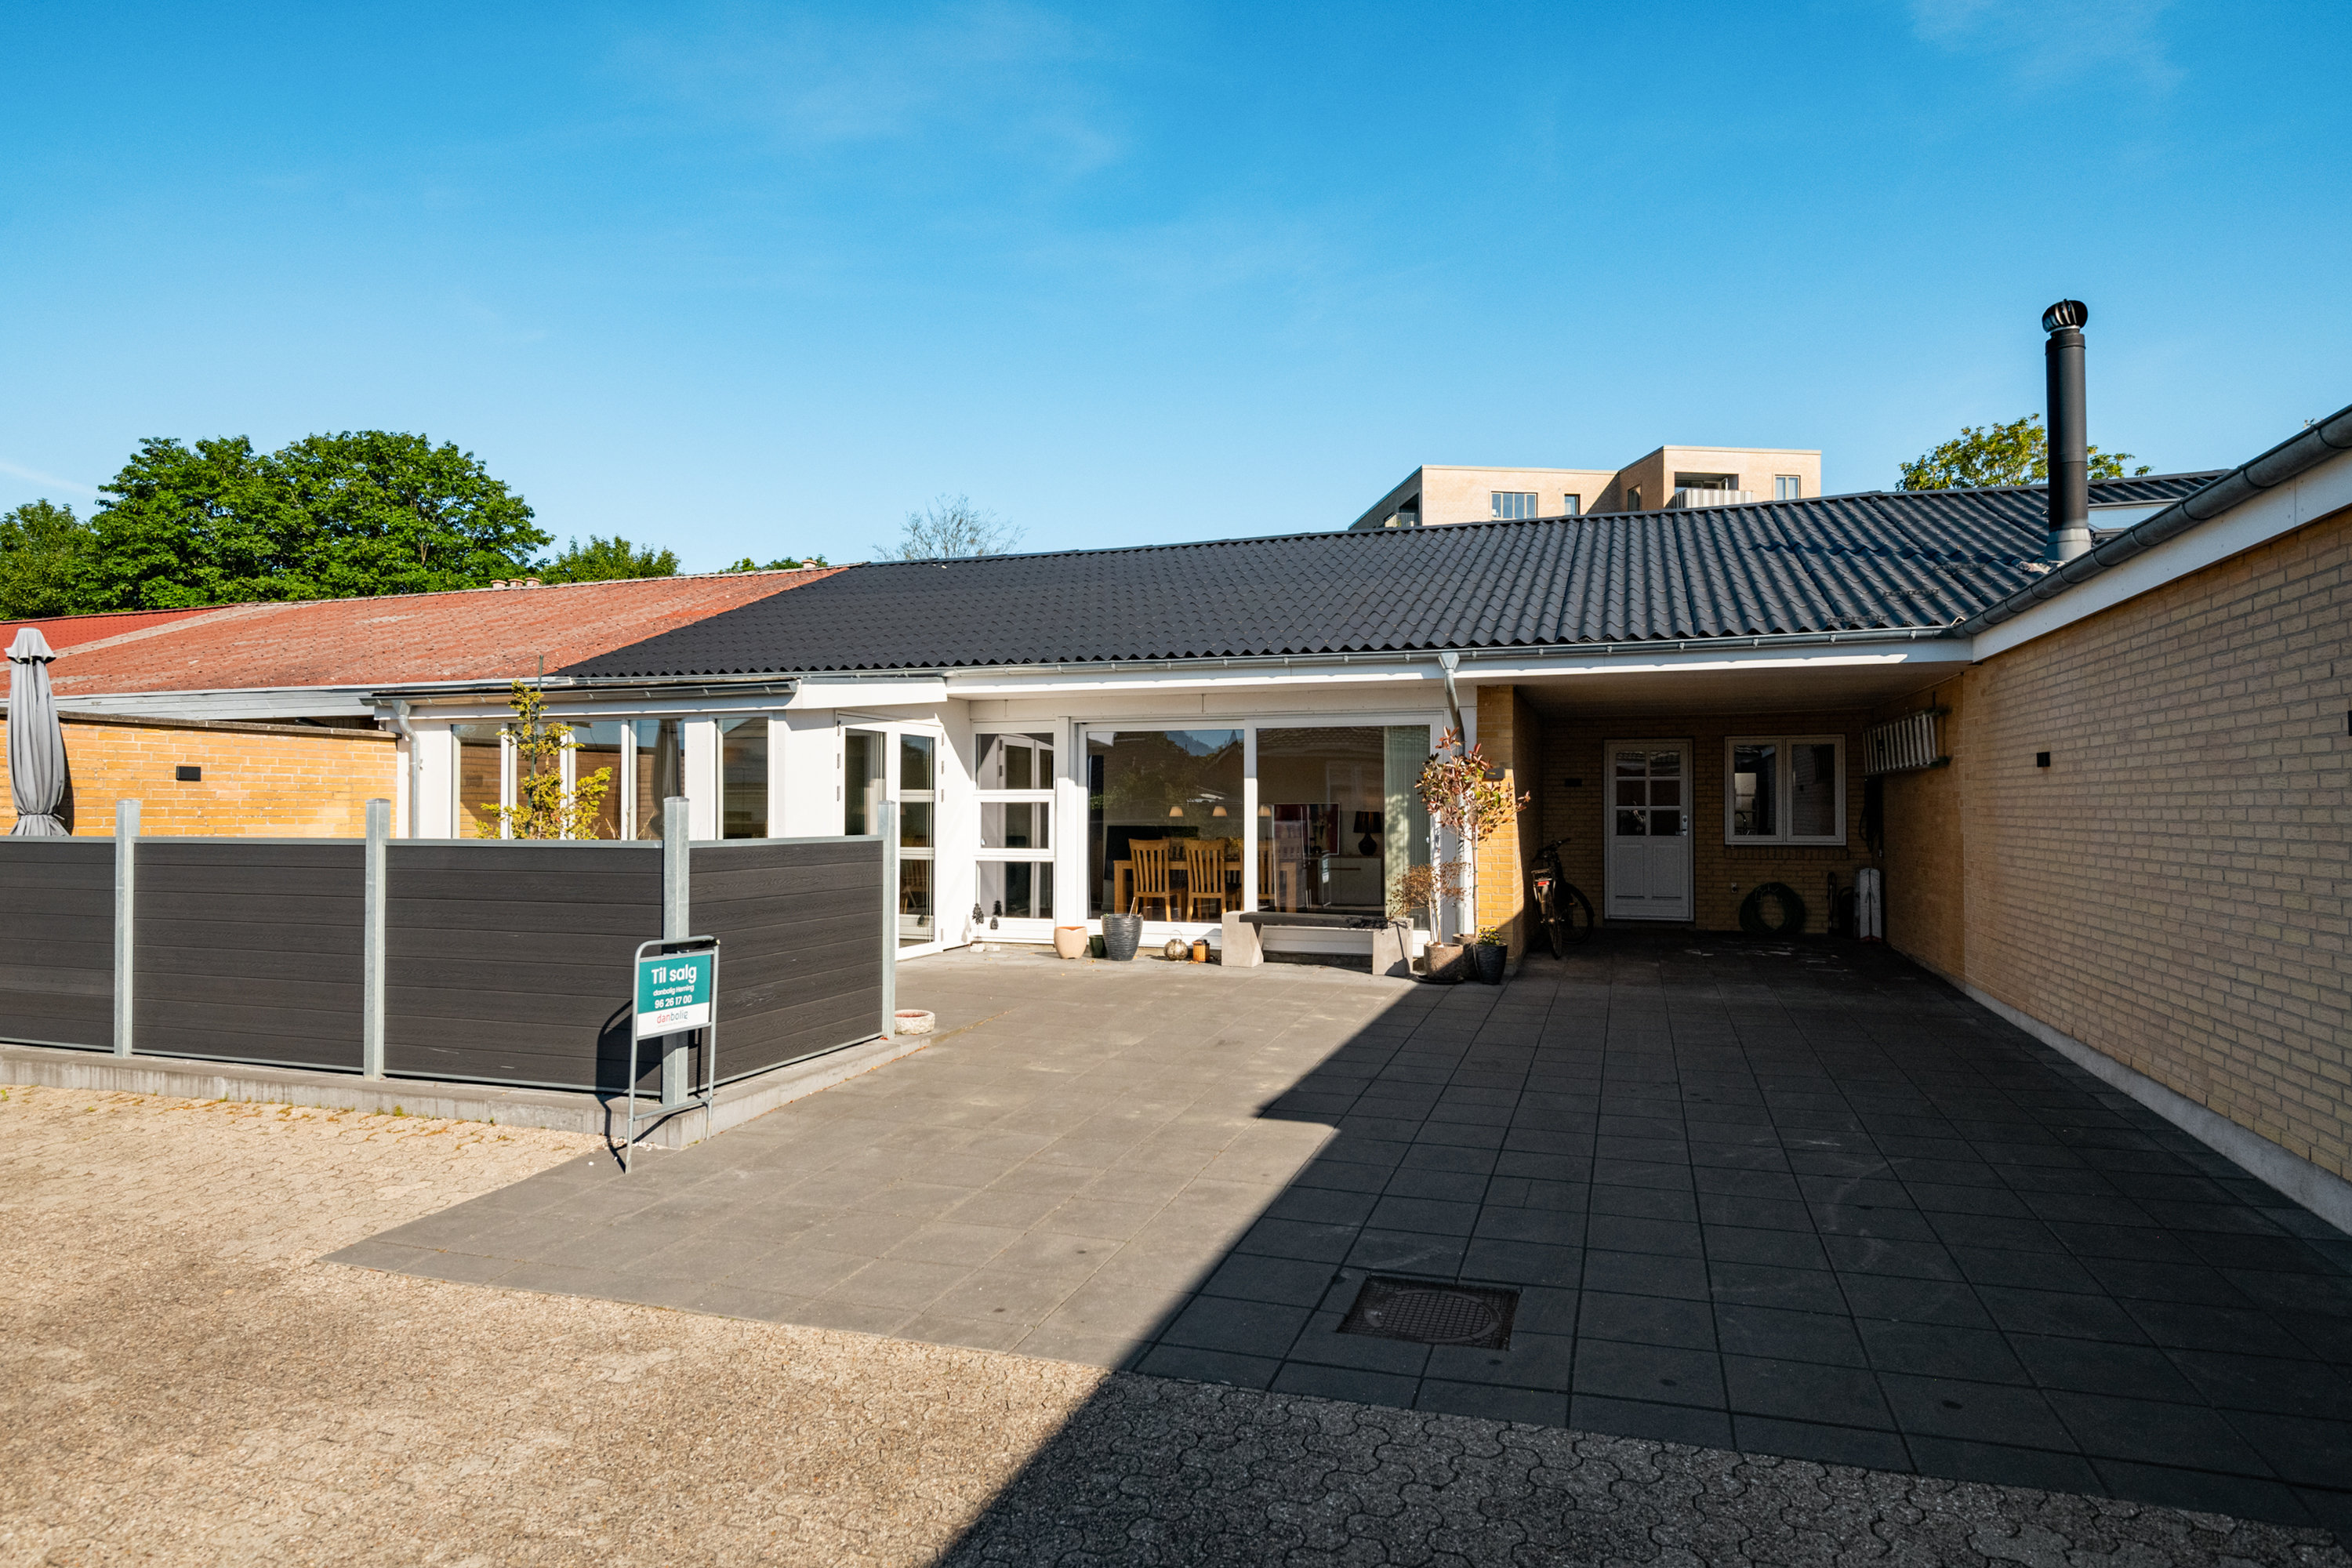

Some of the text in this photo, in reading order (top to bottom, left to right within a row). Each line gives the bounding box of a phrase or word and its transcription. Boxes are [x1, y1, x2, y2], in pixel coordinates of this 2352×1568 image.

[652, 964, 697, 984] Til salg
[653, 987, 676, 996] danbolig
[655, 994, 692, 1009] 96 26 17 00
[657, 1010, 688, 1024] danbolig
